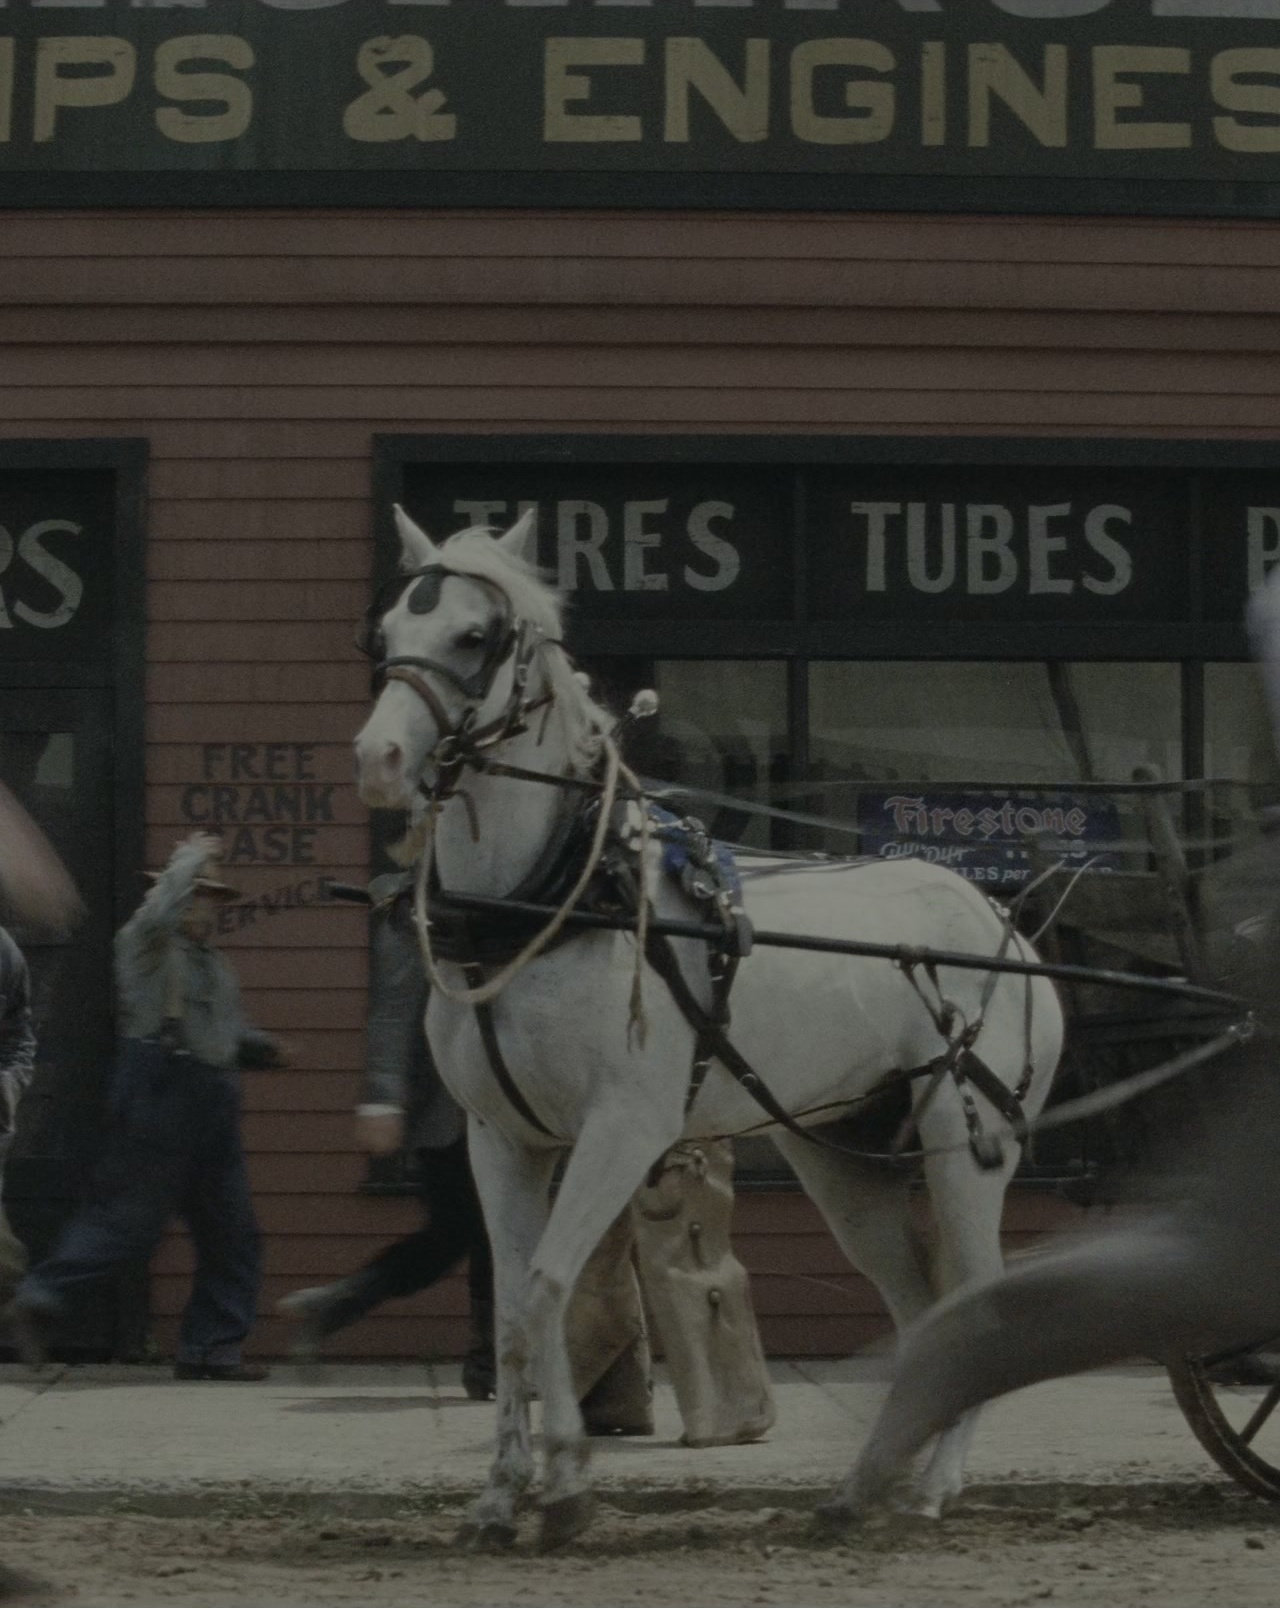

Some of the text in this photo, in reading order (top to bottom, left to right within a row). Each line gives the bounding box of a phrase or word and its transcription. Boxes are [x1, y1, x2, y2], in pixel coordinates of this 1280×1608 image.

[343, 34, 457, 143] &
[851, 501, 1133, 595] TUBES
[202, 743, 316, 780] FREE
[181, 784, 336, 822] CRANK
[883, 796, 1087, 837] Firestone
[1001, 868, 1031, 883] per
[214, 876, 337, 936] ERVICE
